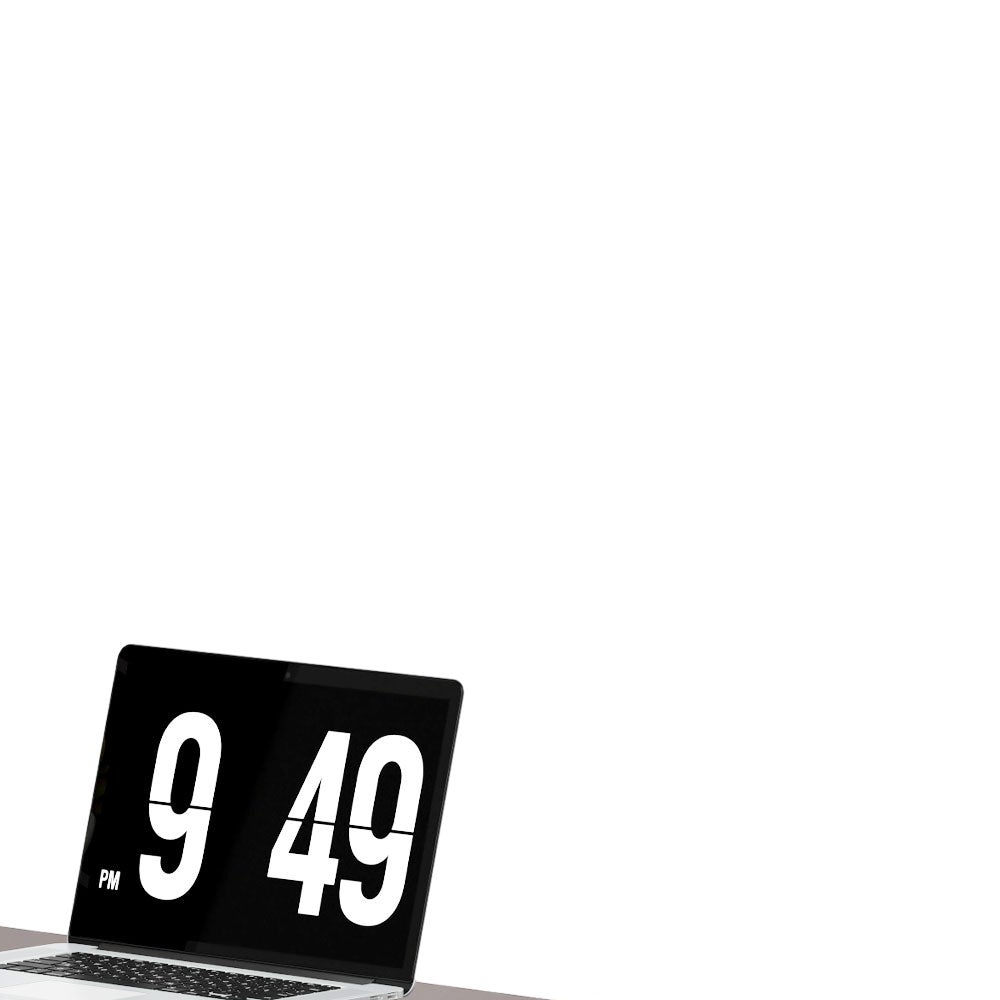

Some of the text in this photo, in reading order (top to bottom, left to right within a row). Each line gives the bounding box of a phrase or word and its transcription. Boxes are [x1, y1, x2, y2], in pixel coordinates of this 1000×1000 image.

[138, 711, 424, 927] 9 49
[98, 868, 121, 892] PM
